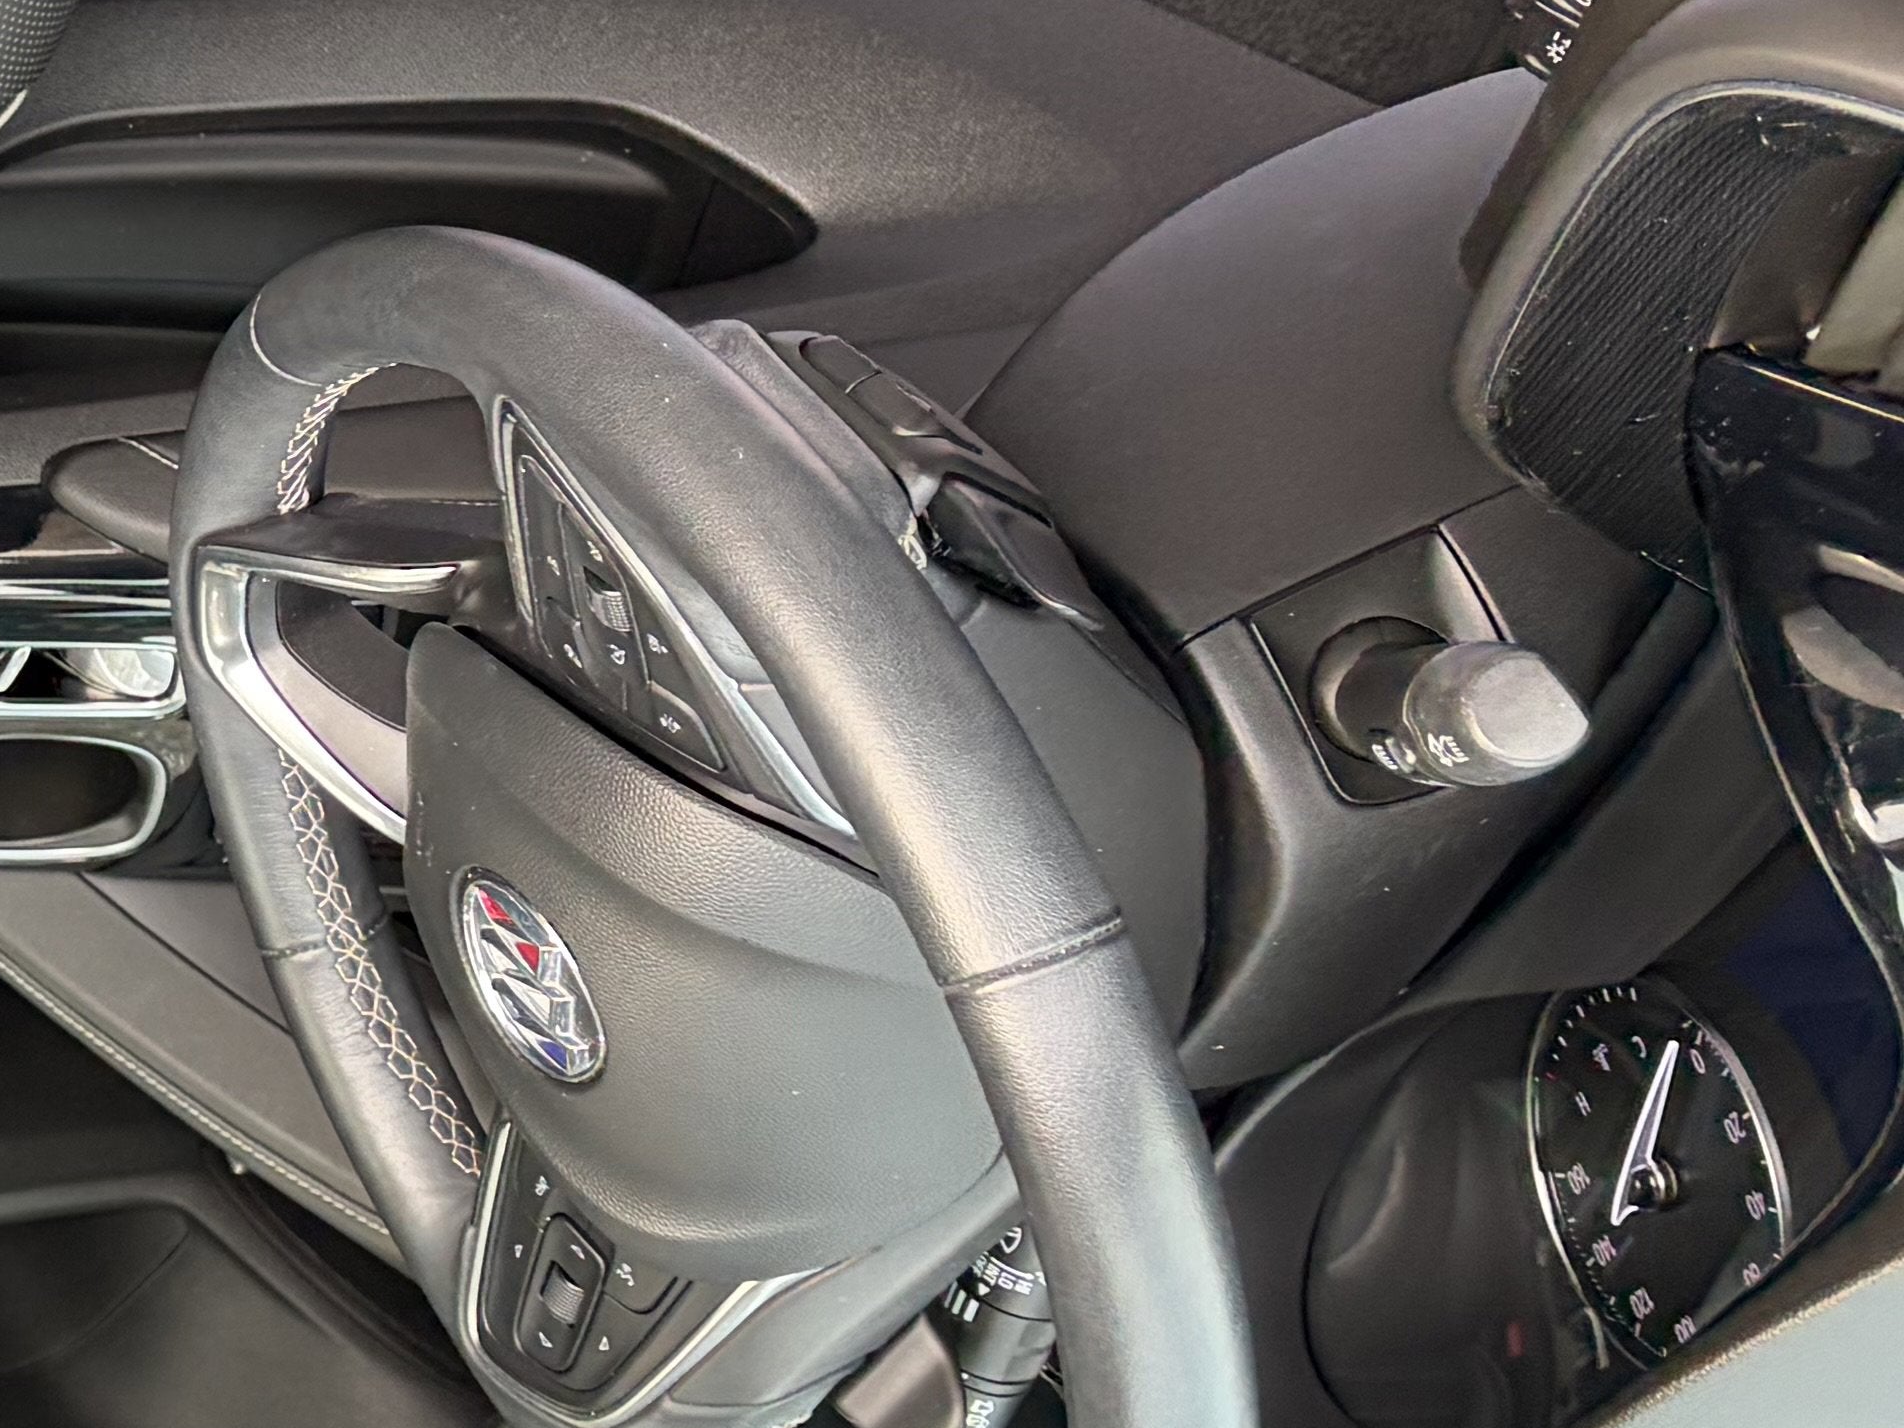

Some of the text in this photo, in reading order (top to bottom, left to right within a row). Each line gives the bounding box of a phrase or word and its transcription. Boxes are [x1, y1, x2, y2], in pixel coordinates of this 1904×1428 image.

[1631, 1036, 1647, 1059] C
[1690, 1048, 1706, 1074] 0
[1575, 1091, 1592, 1117] H
[1724, 1111, 1746, 1144] 20
[1567, 1162, 1590, 1195] 160
[1745, 1189, 1766, 1220] 40
[1592, 1235, 1617, 1267] 140
[982, 1263, 1001, 1286] INT
[998, 1272, 1017, 1290] LO
[1629, 1287, 1655, 1319] 120
